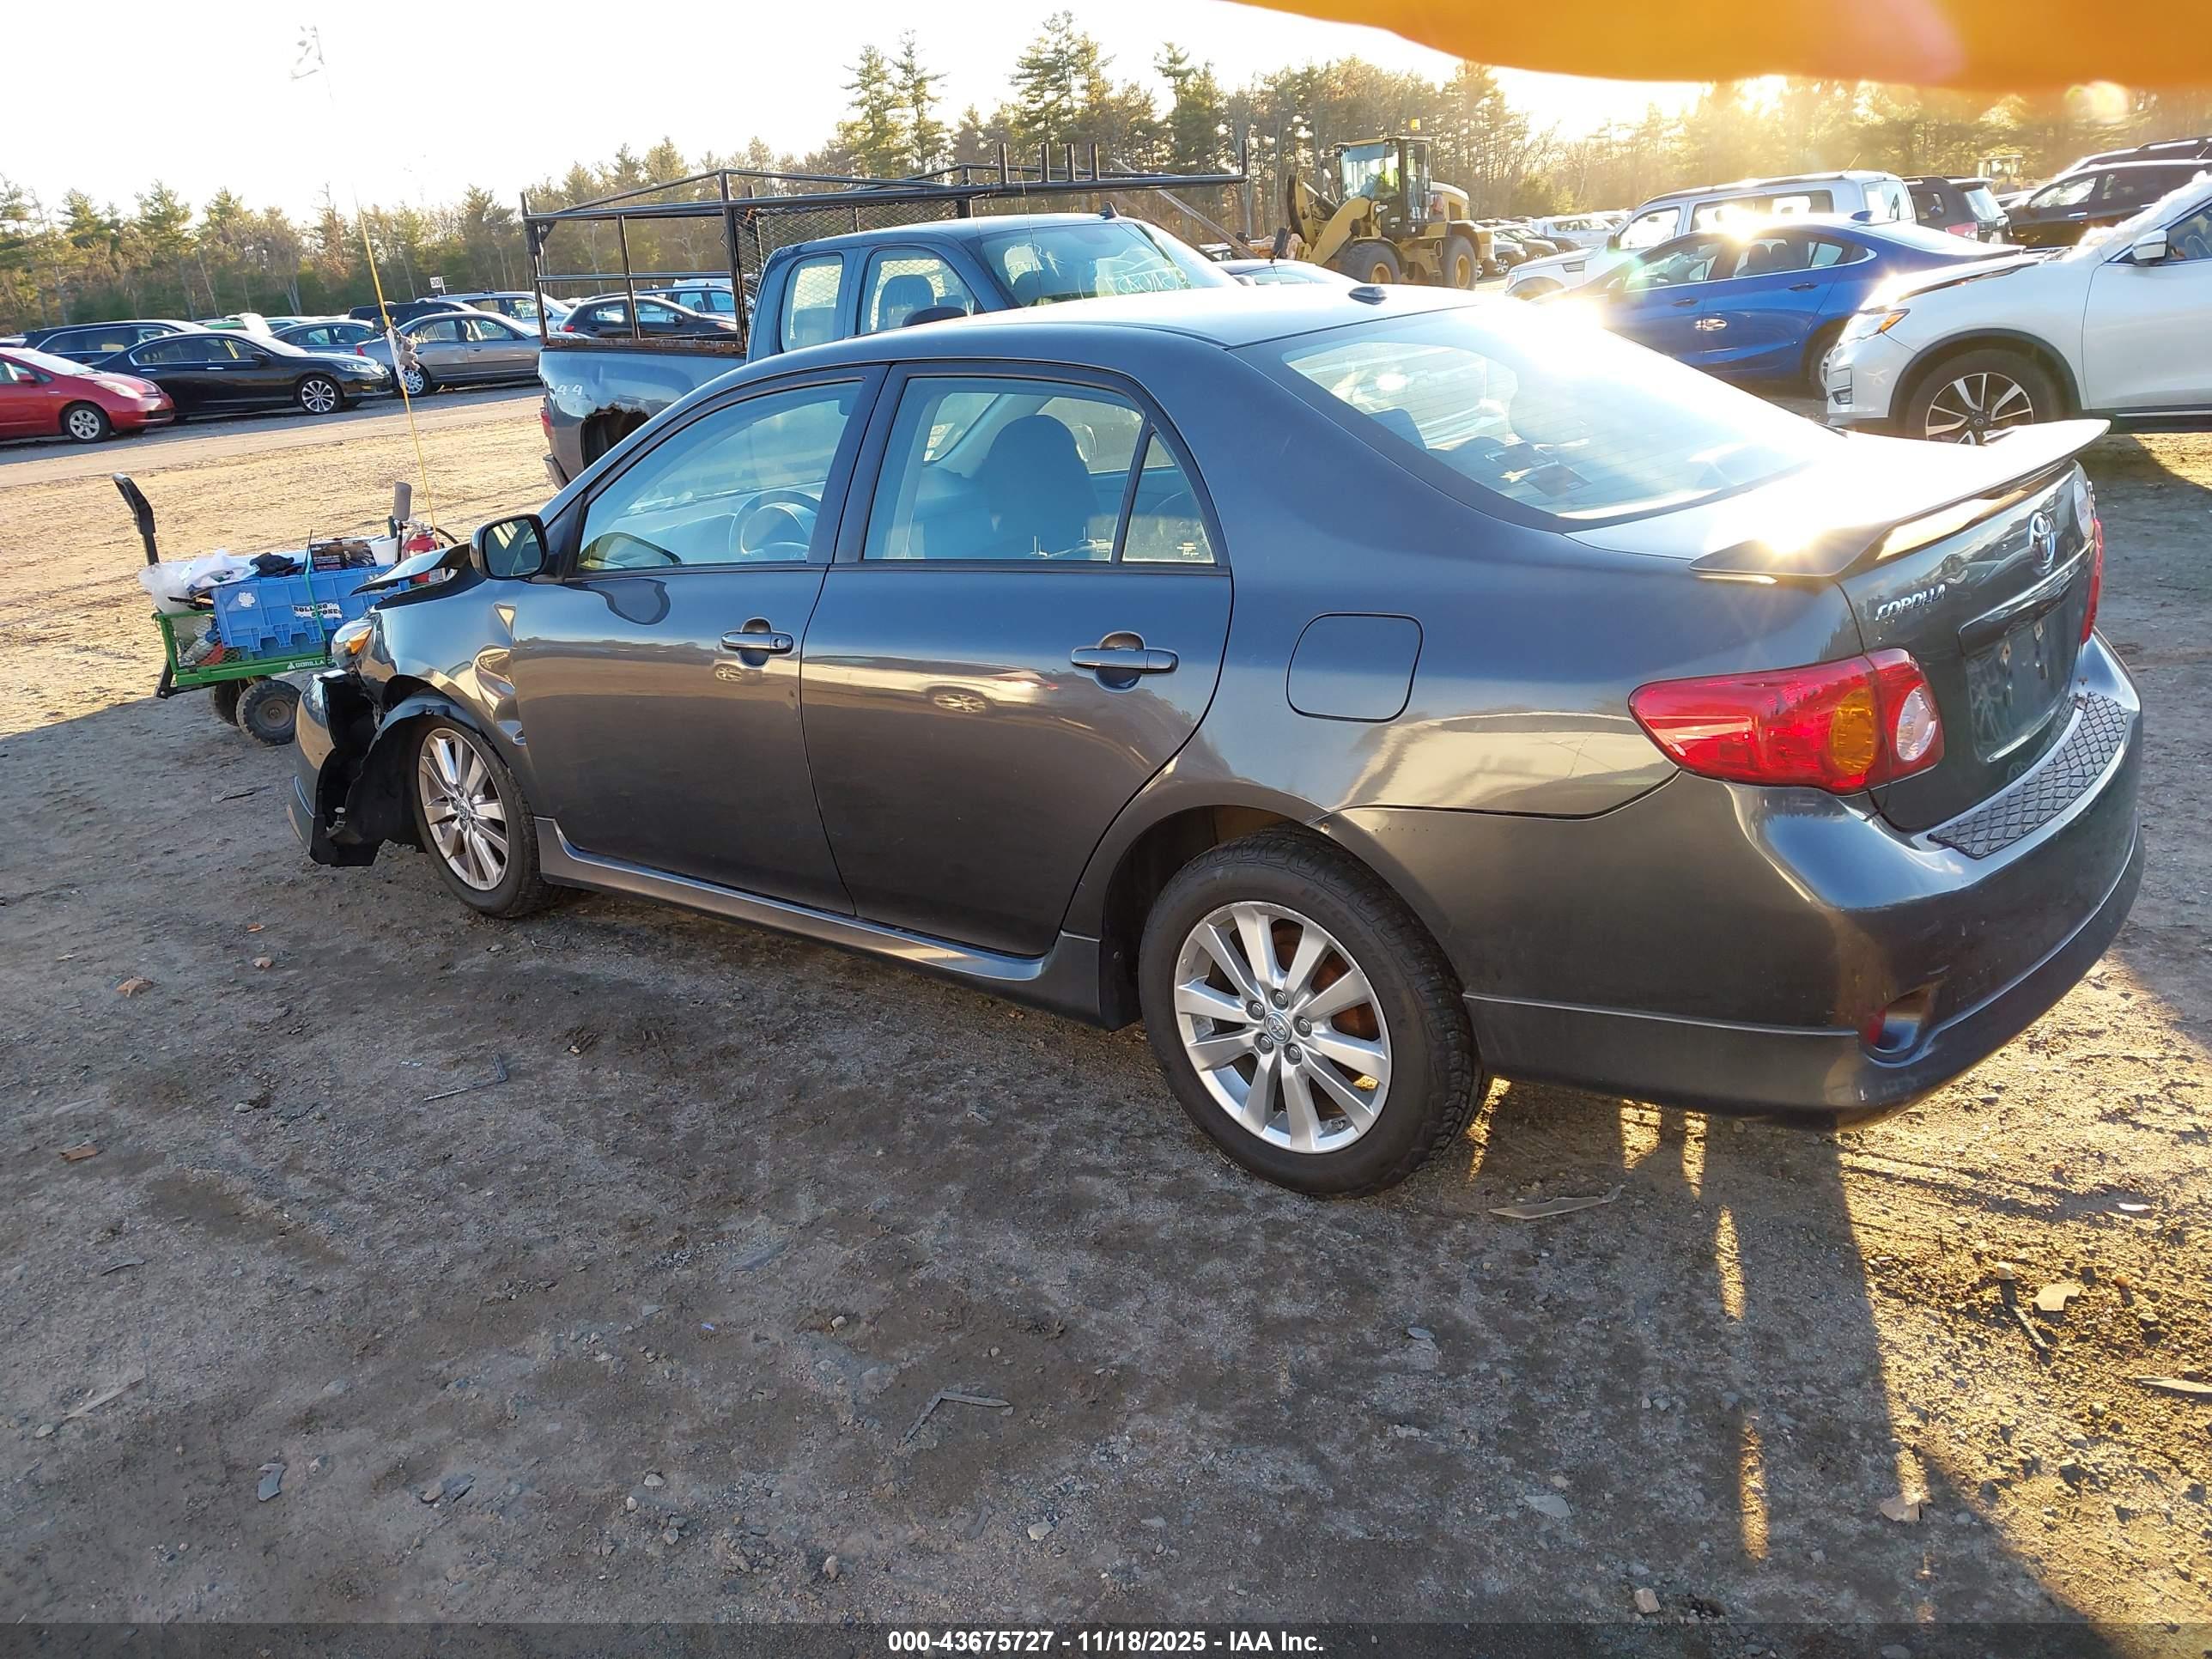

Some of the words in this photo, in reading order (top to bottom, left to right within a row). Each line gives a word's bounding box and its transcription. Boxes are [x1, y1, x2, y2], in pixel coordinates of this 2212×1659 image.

[1875, 584, 1946, 621] COROLLA
[293, 604, 328, 612] ROLLNG
[295, 659, 325, 668] GORILLA
